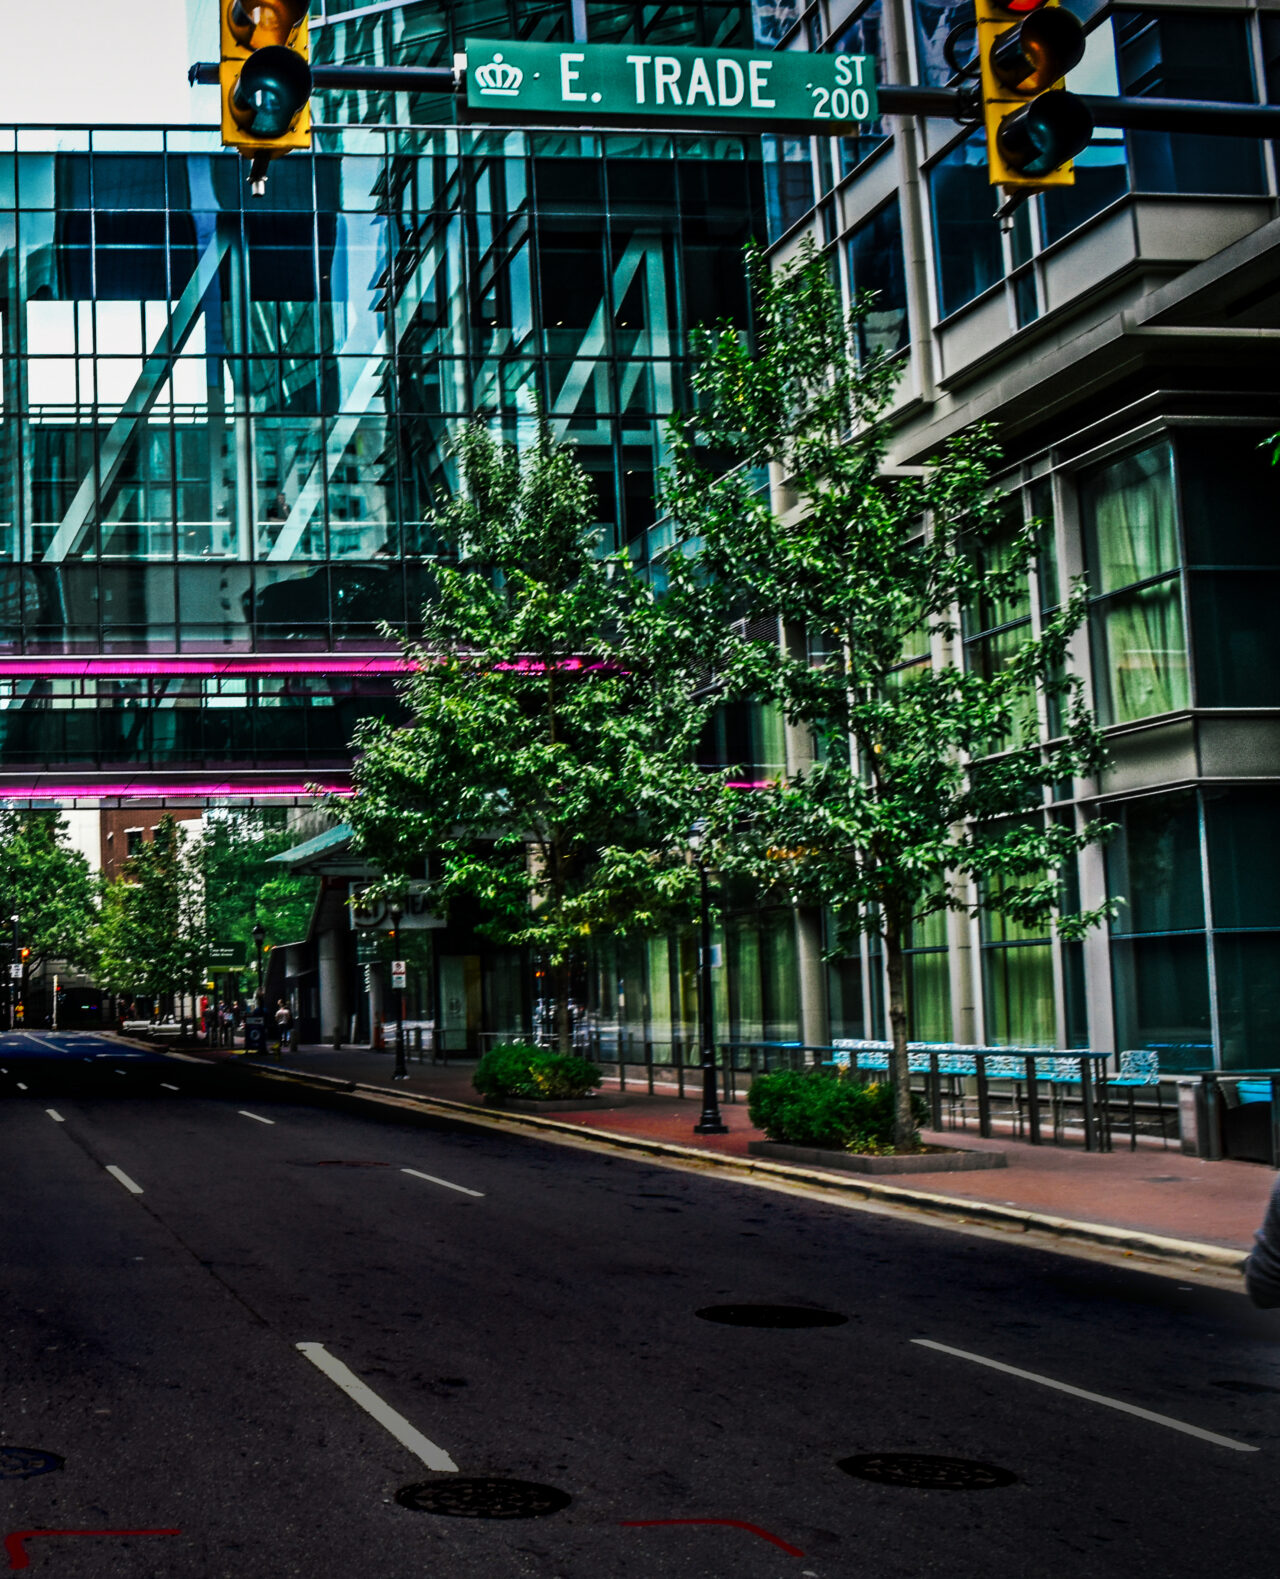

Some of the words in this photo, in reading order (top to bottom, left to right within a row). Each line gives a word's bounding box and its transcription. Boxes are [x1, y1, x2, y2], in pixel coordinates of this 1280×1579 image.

[560, 52, 602, 103] E.
[626, 54, 776, 108] TRADE
[834, 55, 866, 87] ST
[812, 87, 869, 119] 200
